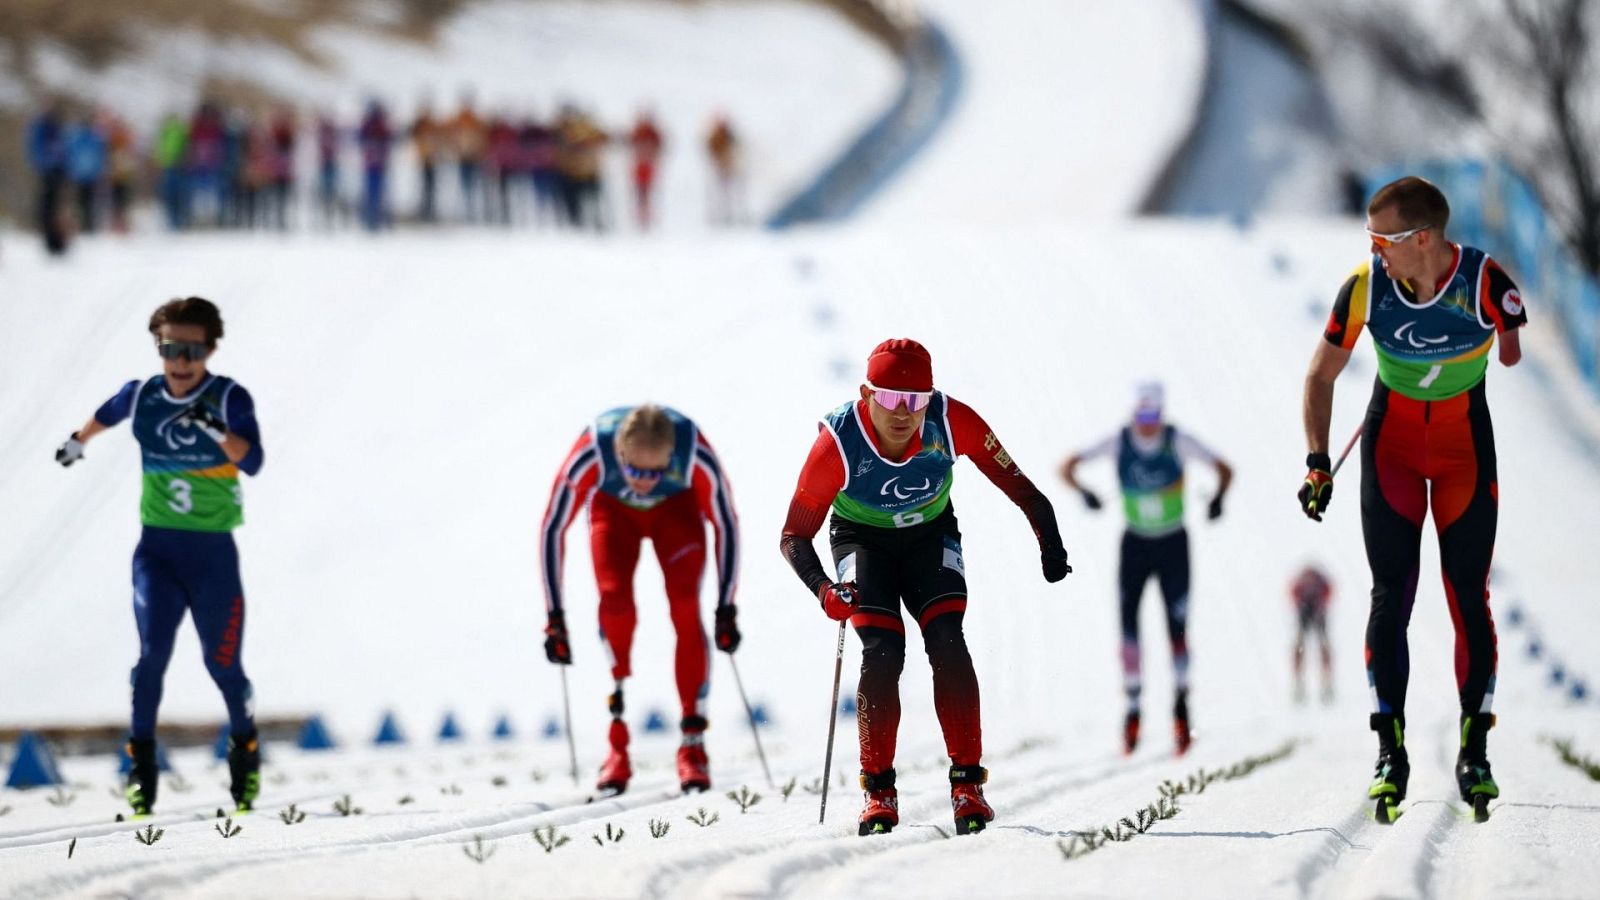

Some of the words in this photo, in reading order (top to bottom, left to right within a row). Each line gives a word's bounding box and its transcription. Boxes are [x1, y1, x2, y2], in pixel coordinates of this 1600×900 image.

[984, 431, 1012, 469] 中国
[168, 479, 192, 514] 3
[856, 691, 873, 763] CHINA
